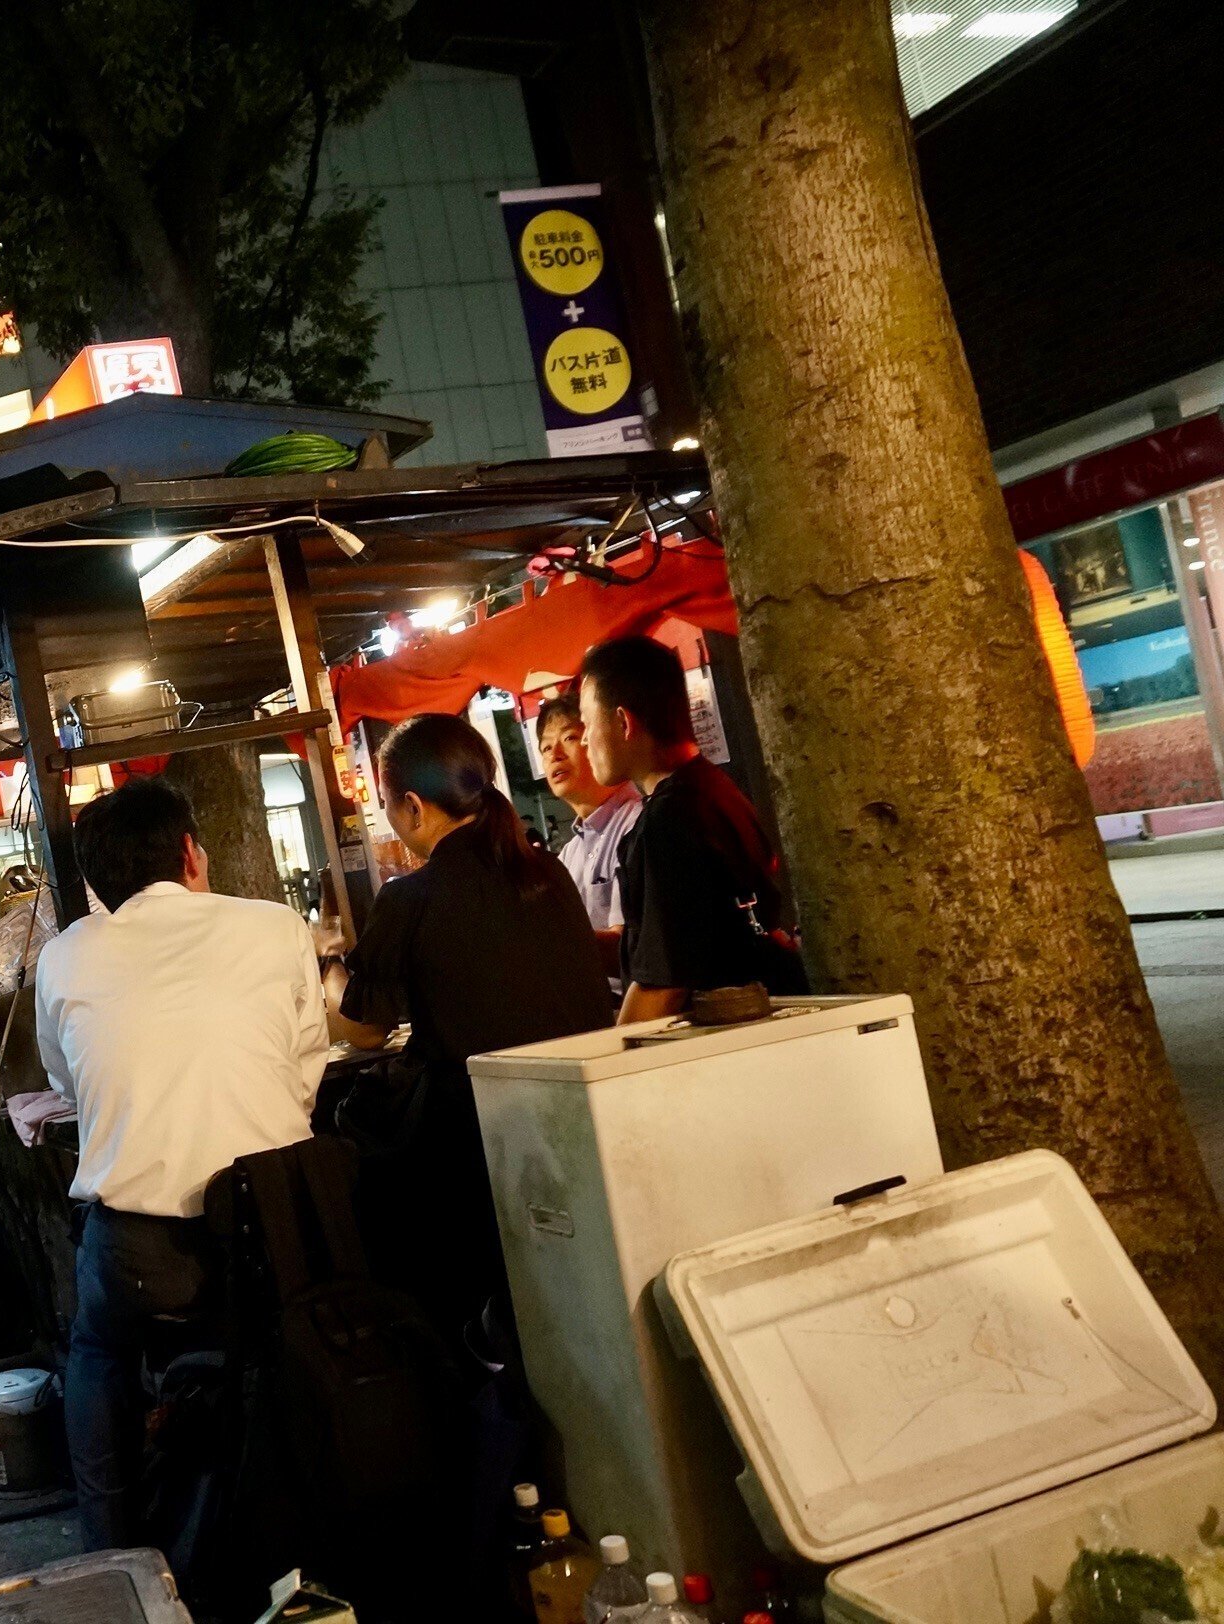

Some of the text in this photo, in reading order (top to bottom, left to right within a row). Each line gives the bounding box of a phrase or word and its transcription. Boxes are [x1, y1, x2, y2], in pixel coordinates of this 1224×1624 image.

[551, 345, 623, 372] バス片道
[570, 372, 608, 395] 無料
